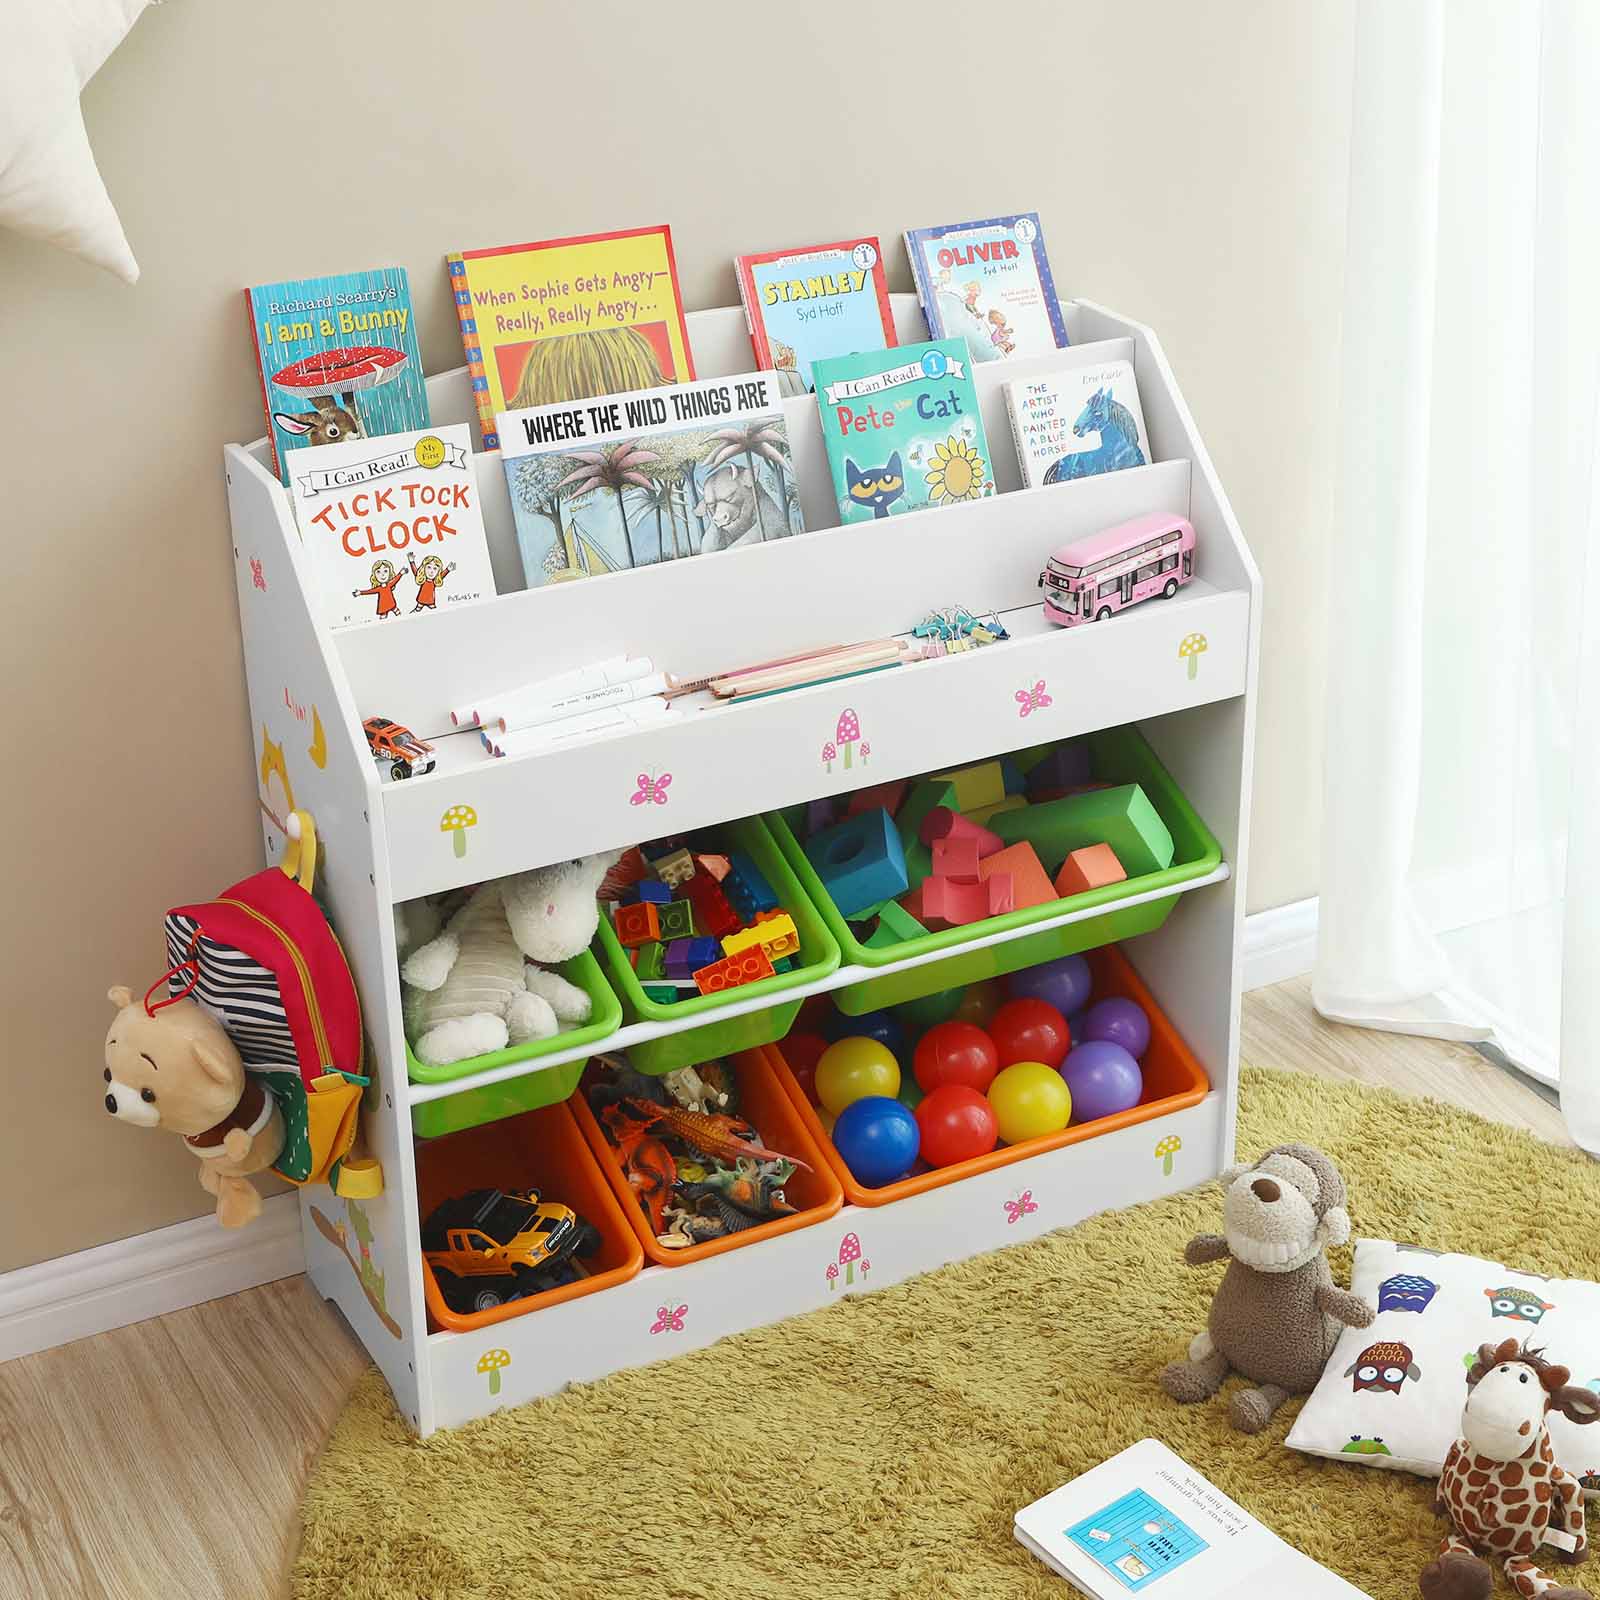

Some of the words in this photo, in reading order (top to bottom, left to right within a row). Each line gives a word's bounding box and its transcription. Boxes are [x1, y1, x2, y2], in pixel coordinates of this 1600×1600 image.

[861, 249, 870, 264] 1
[937, 239, 1020, 269] OLIVER
[983, 266, 997, 276] Syd
[474, 289, 516, 307] When
[521, 280, 569, 304] Sophie
[575, 271, 607, 293] Gets
[764, 271, 867, 306] STANLEY
[269, 295, 333, 316] Richard
[335, 286, 397, 307] Scarry's
[495, 310, 544, 334] Really,
[550, 304, 591, 326] Really
[796, 306, 817, 323] Syd
[820, 302, 844, 318] Hoff
[264, 321, 273, 345] I
[279, 320, 314, 343] am
[320, 318, 335, 337] a
[339, 307, 408, 336] Bunny
[928, 356, 939, 372] 1
[844, 385, 851, 396] I
[853, 381, 880, 395] Can
[882, 366, 918, 387] Read!
[1026, 383, 1048, 395] THE
[1022, 394, 1059, 410] ARTIST
[522, 409, 586, 445] WHERE
[587, 404, 622, 434] THE
[625, 397, 667, 428] WILD
[670, 386, 732, 421] THINGS
[734, 381, 769, 411] ARE
[837, 405, 896, 436] Pete
[916, 390, 963, 420] Cat
[1031, 408, 1055, 420] WHO
[1023, 418, 1067, 435] PAINTED
[422, 443, 436, 454] My
[1030, 437, 1037, 447] A
[1040, 431, 1065, 444] BLUE
[421, 452, 440, 461] First
[1033, 445, 1068, 458] HORSE
[324, 473, 330, 487] I
[334, 470, 365, 486] Can
[368, 454, 410, 478] Read!
[311, 487, 398, 532] TICK
[401, 483, 470, 509] TOCK
[341, 512, 457, 557] CLOCK
[1193, 1497, 1206, 1510] too
[1208, 1510, 1223, 1524] was
[1225, 1525, 1238, 1536] He
[1148, 1540, 1171, 1561] WITH
